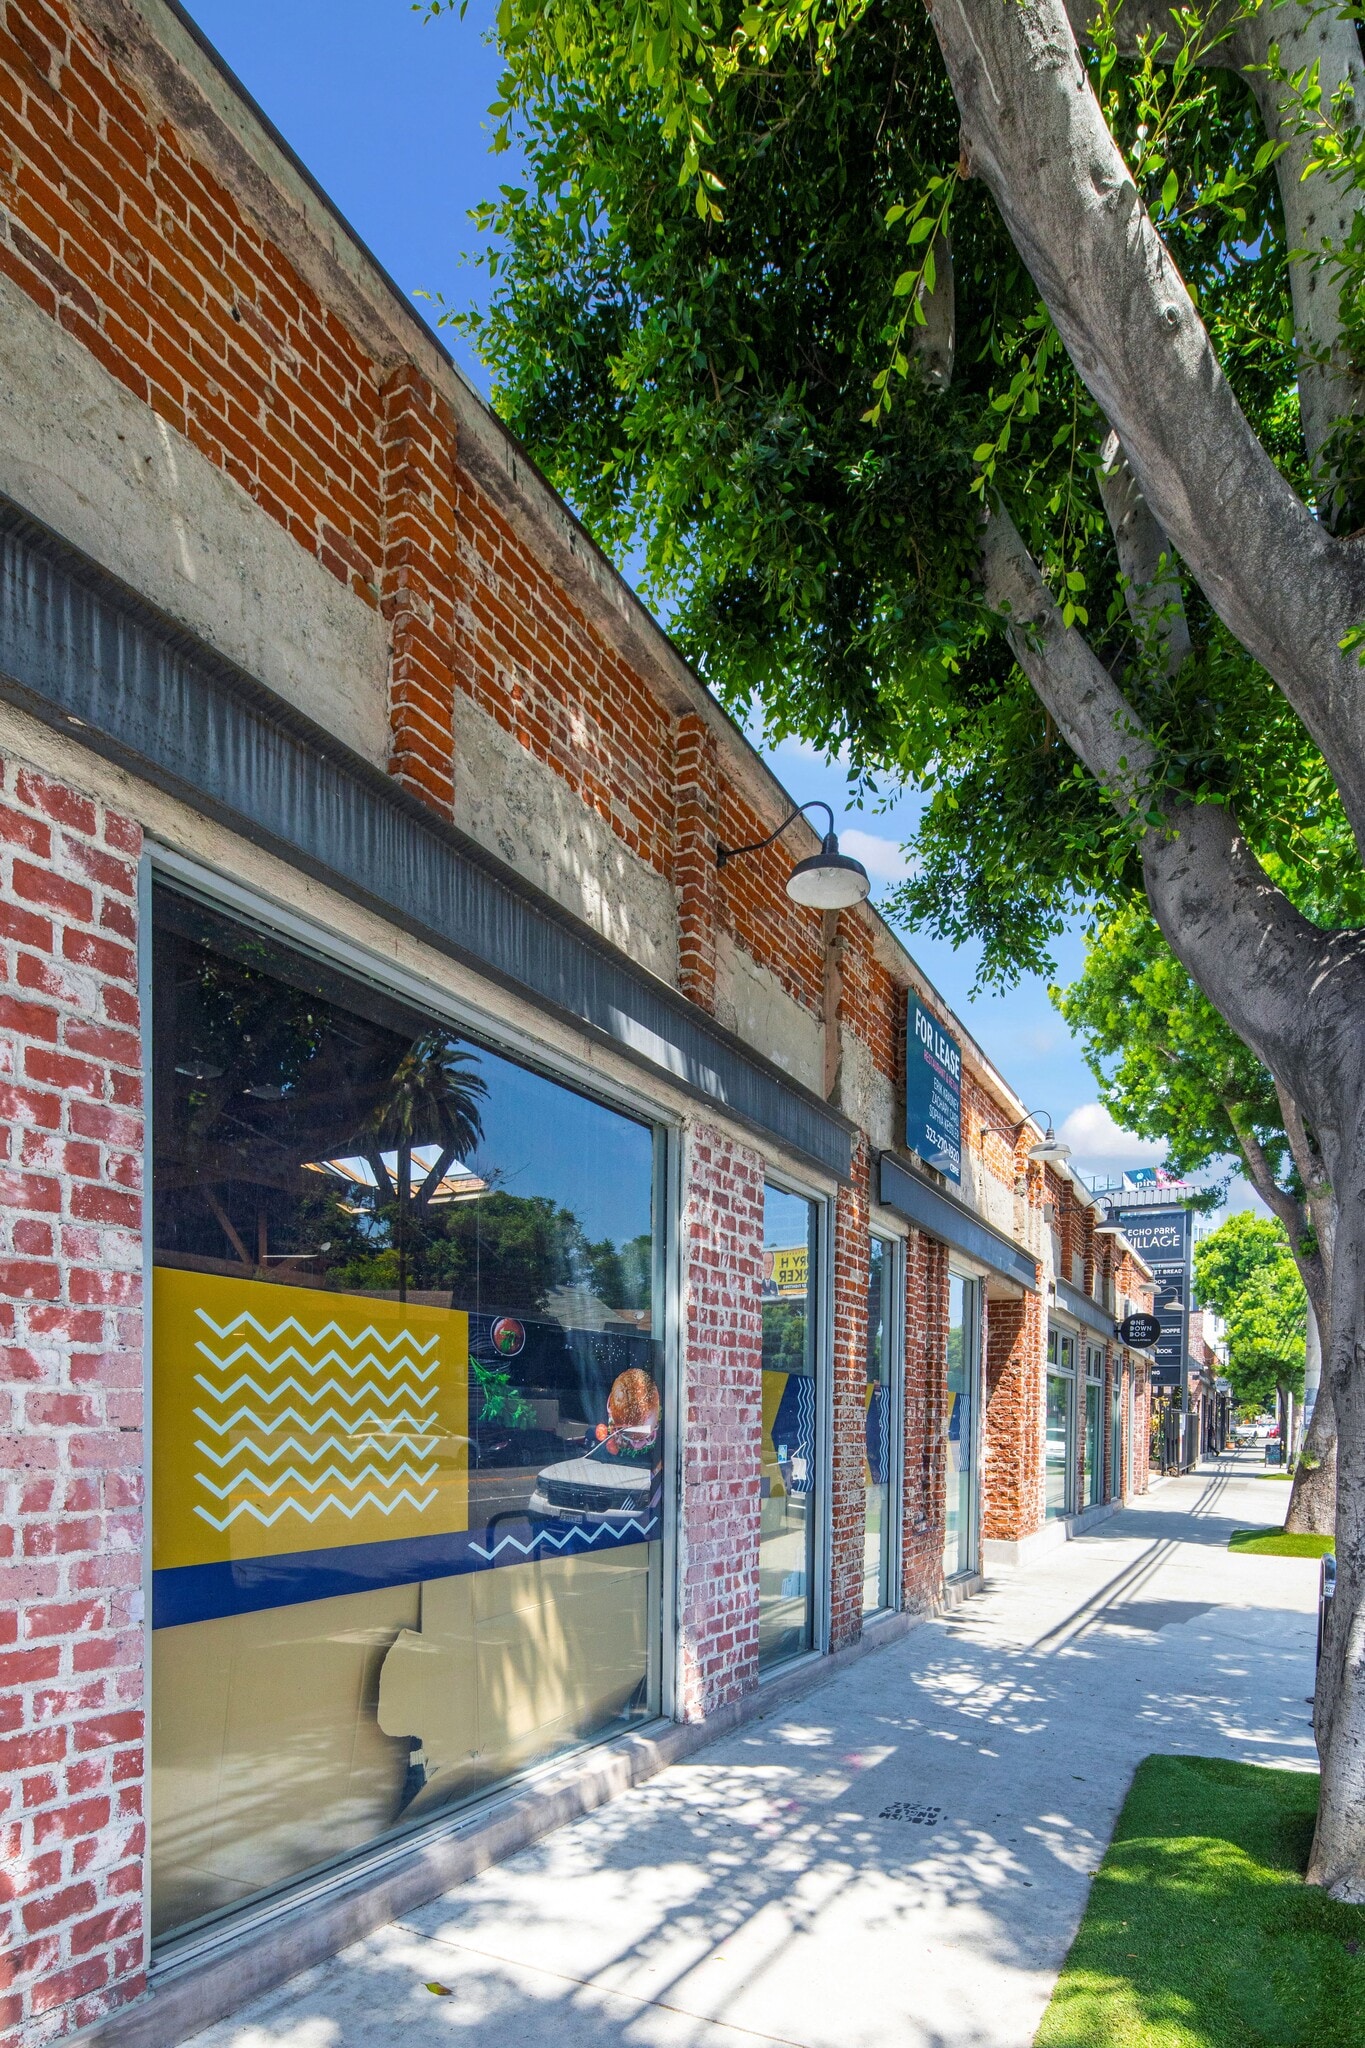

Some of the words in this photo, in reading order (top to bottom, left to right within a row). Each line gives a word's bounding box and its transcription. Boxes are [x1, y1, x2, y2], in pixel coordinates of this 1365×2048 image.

[915, 1007, 933, 1052] FOR
[935, 1030, 960, 1081] LEASE
[933, 1077, 942, 1094] ERIK
[931, 1090, 949, 1116] ZACHARY
[925, 1124, 960, 1164] 323-270-1920
[949, 1163, 960, 1177] CBRE
[1127, 1228, 1152, 1237] ECHO
